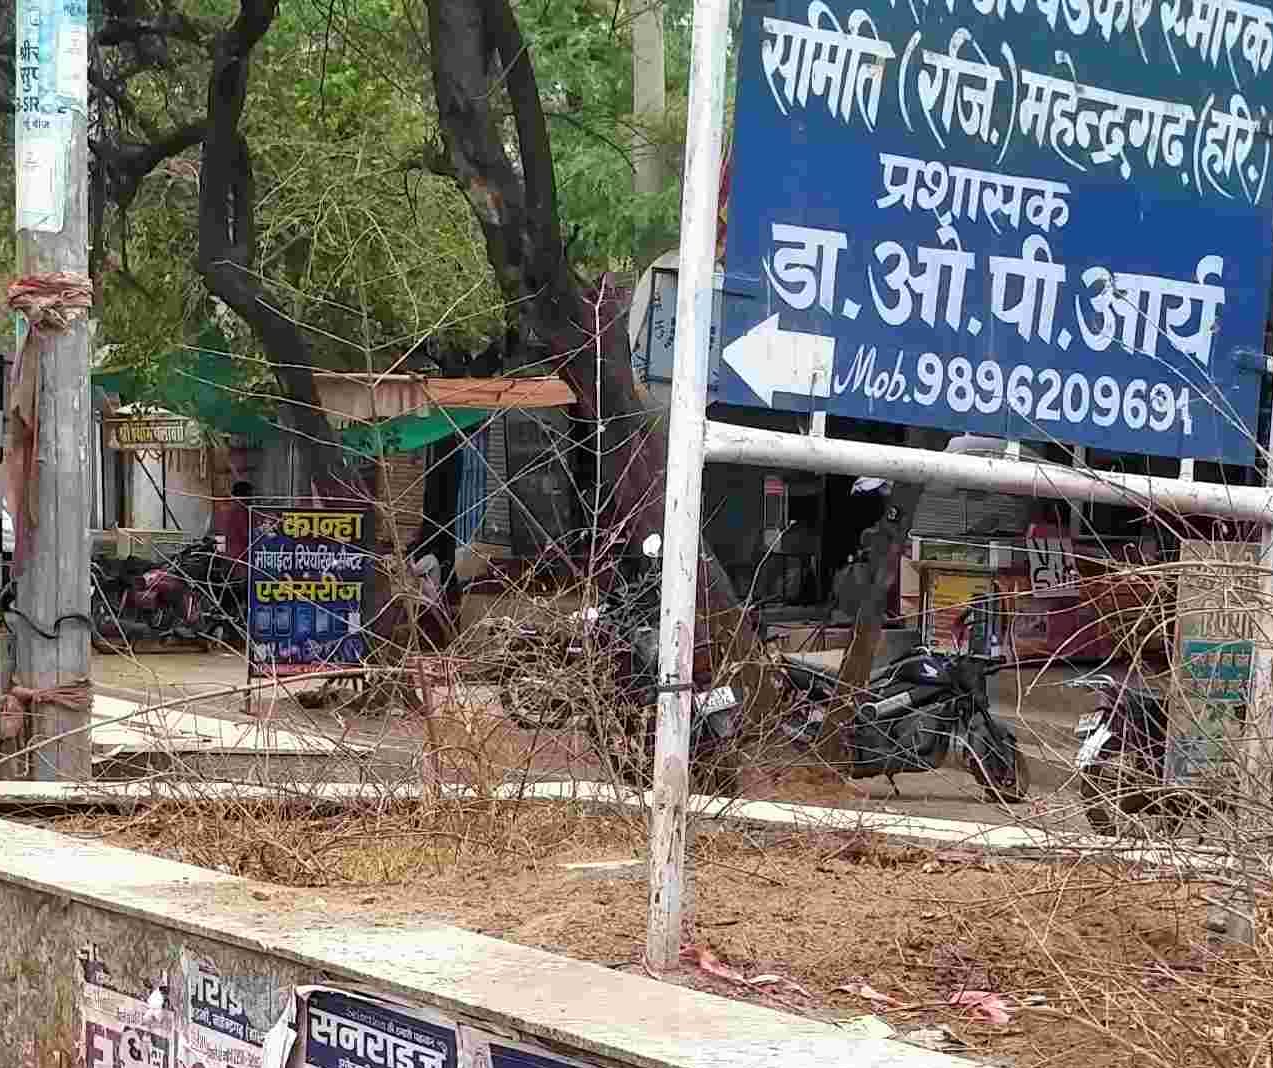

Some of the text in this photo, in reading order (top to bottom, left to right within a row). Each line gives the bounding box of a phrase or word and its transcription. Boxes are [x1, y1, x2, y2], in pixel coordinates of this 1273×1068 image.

[761, 1, 896, 132] समिति
[877, 152, 1072, 232] प्रशासक
[914, 353, 1194, 436] 9896209691
[283, 512, 363, 540] कान्हा
